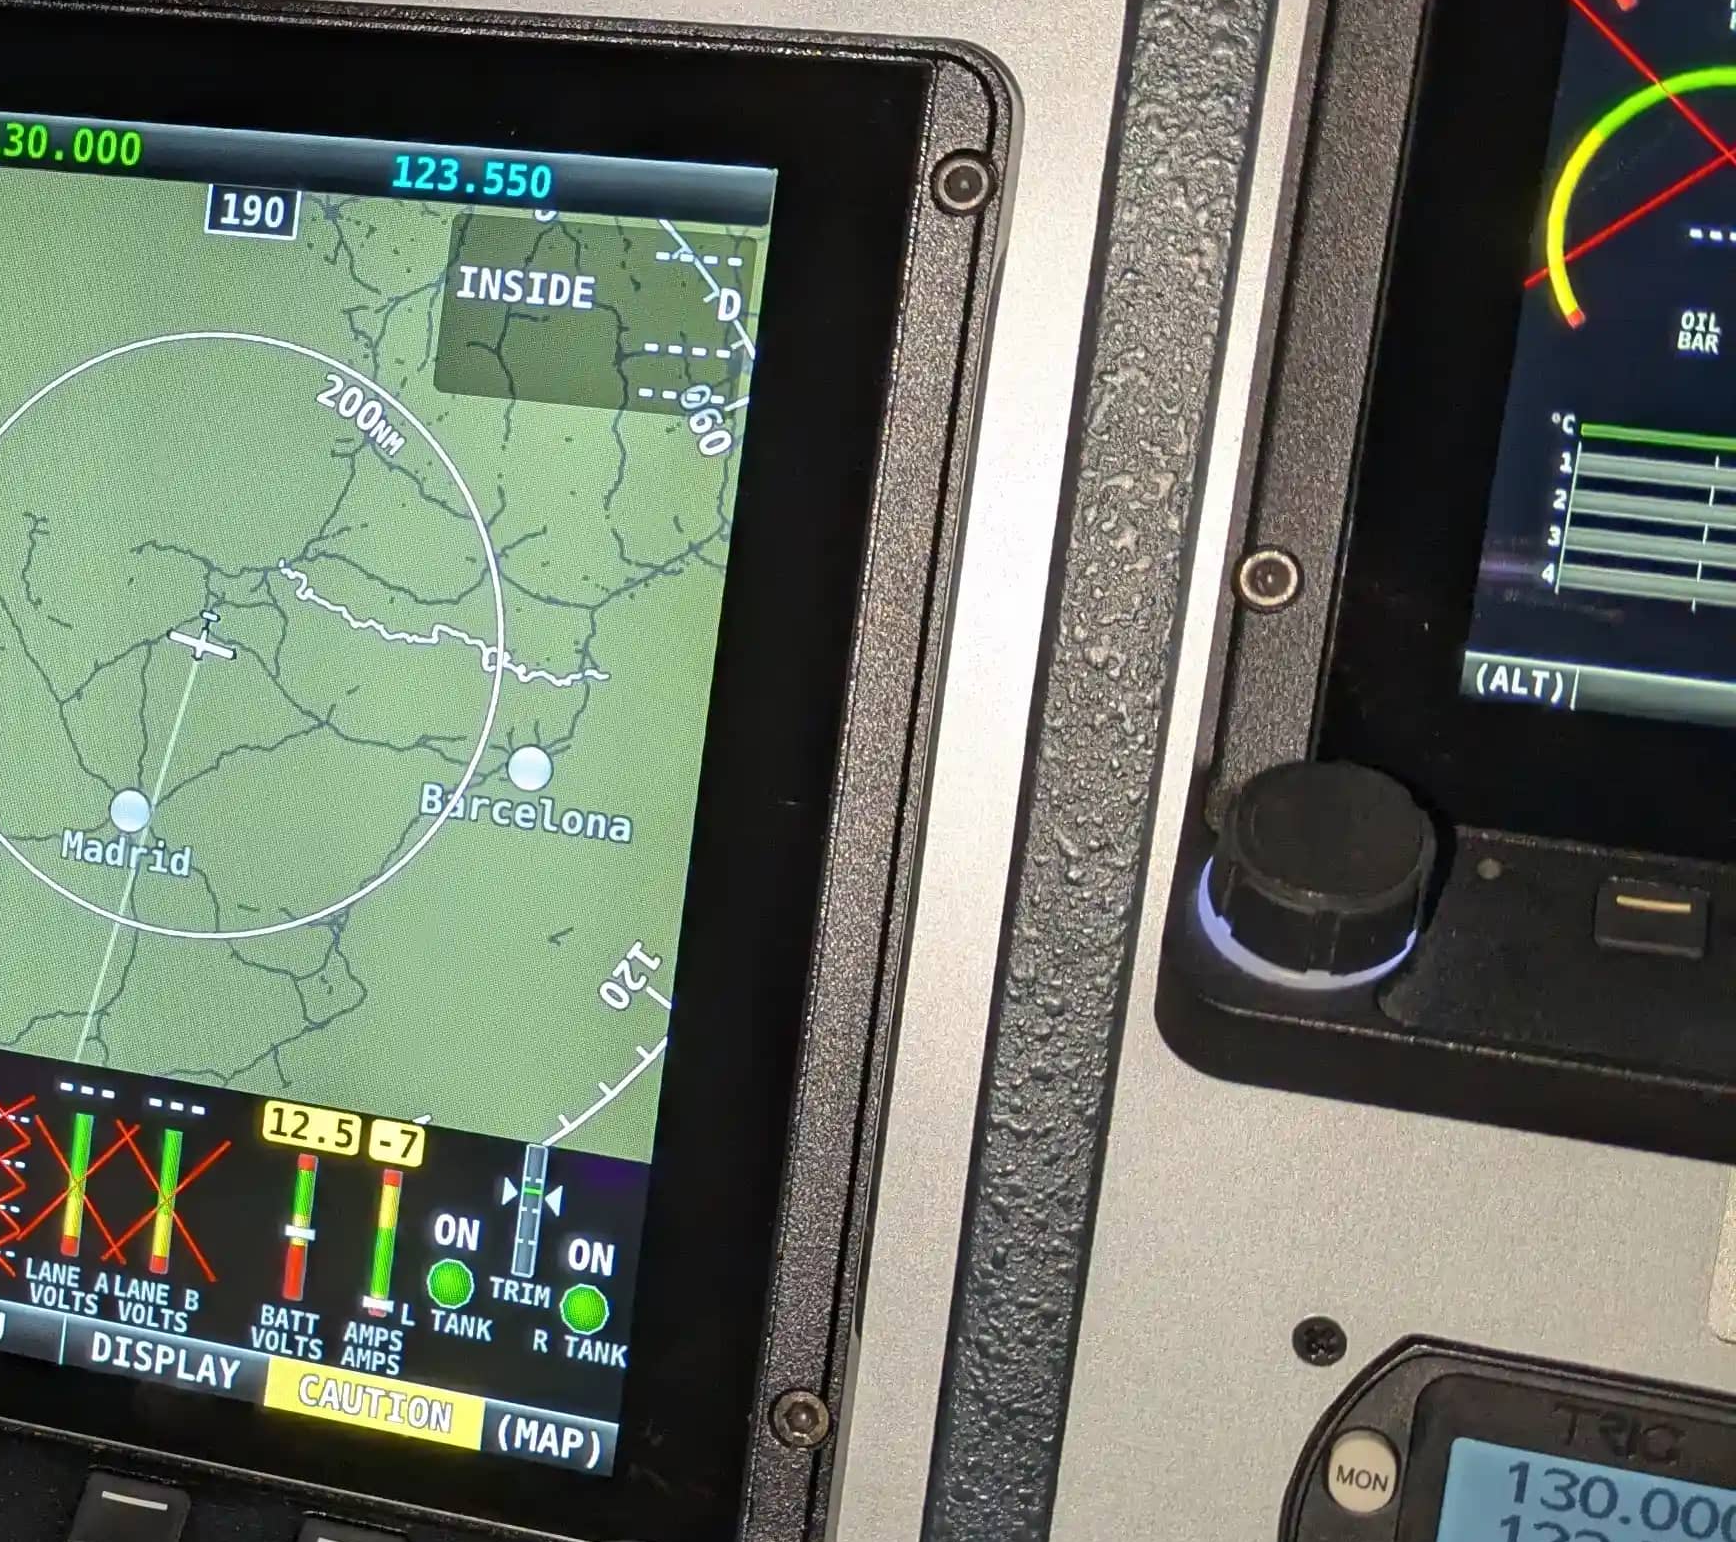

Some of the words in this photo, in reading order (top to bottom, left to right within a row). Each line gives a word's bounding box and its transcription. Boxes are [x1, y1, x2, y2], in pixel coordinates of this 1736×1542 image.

[391, 156, 553, 198] 123.550
[219, 193, 286, 228] 190
[455, 265, 596, 309] INSIDE
[1475, 663, 1564, 705] (ALT)
[419, 782, 634, 844] Barcelona
[61, 829, 192, 878] Madrid
[269, 1107, 355, 1148] 12.5
[379, 1130, 418, 1159] -7
[434, 1213, 481, 1251] ON
[568, 1238, 615, 1276] ON
[26, 1258, 80, 1288] LANE
[94, 1272, 109, 1296] A
[115, 1279, 170, 1306] LANE
[185, 1290, 199, 1310] B
[490, 1276, 551, 1309] TRIM
[30, 1283, 98, 1315] VOLTS
[118, 1299, 188, 1332] VOLTS
[260, 1304, 320, 1334] BATT
[344, 1321, 404, 1351] AMPS
[401, 1302, 415, 1327] L
[431, 1309, 493, 1342] TANK
[91, 1331, 241, 1389] DISPLAY
[251, 1327, 324, 1360] VOLTS
[340, 1348, 400, 1376] AMPS
[533, 1329, 548, 1354] R
[564, 1335, 628, 1368] TANK
[298, 1375, 453, 1433] CAUTION
[498, 1414, 601, 1468] (MAP)
[1336, 1464, 1389, 1492] MON
